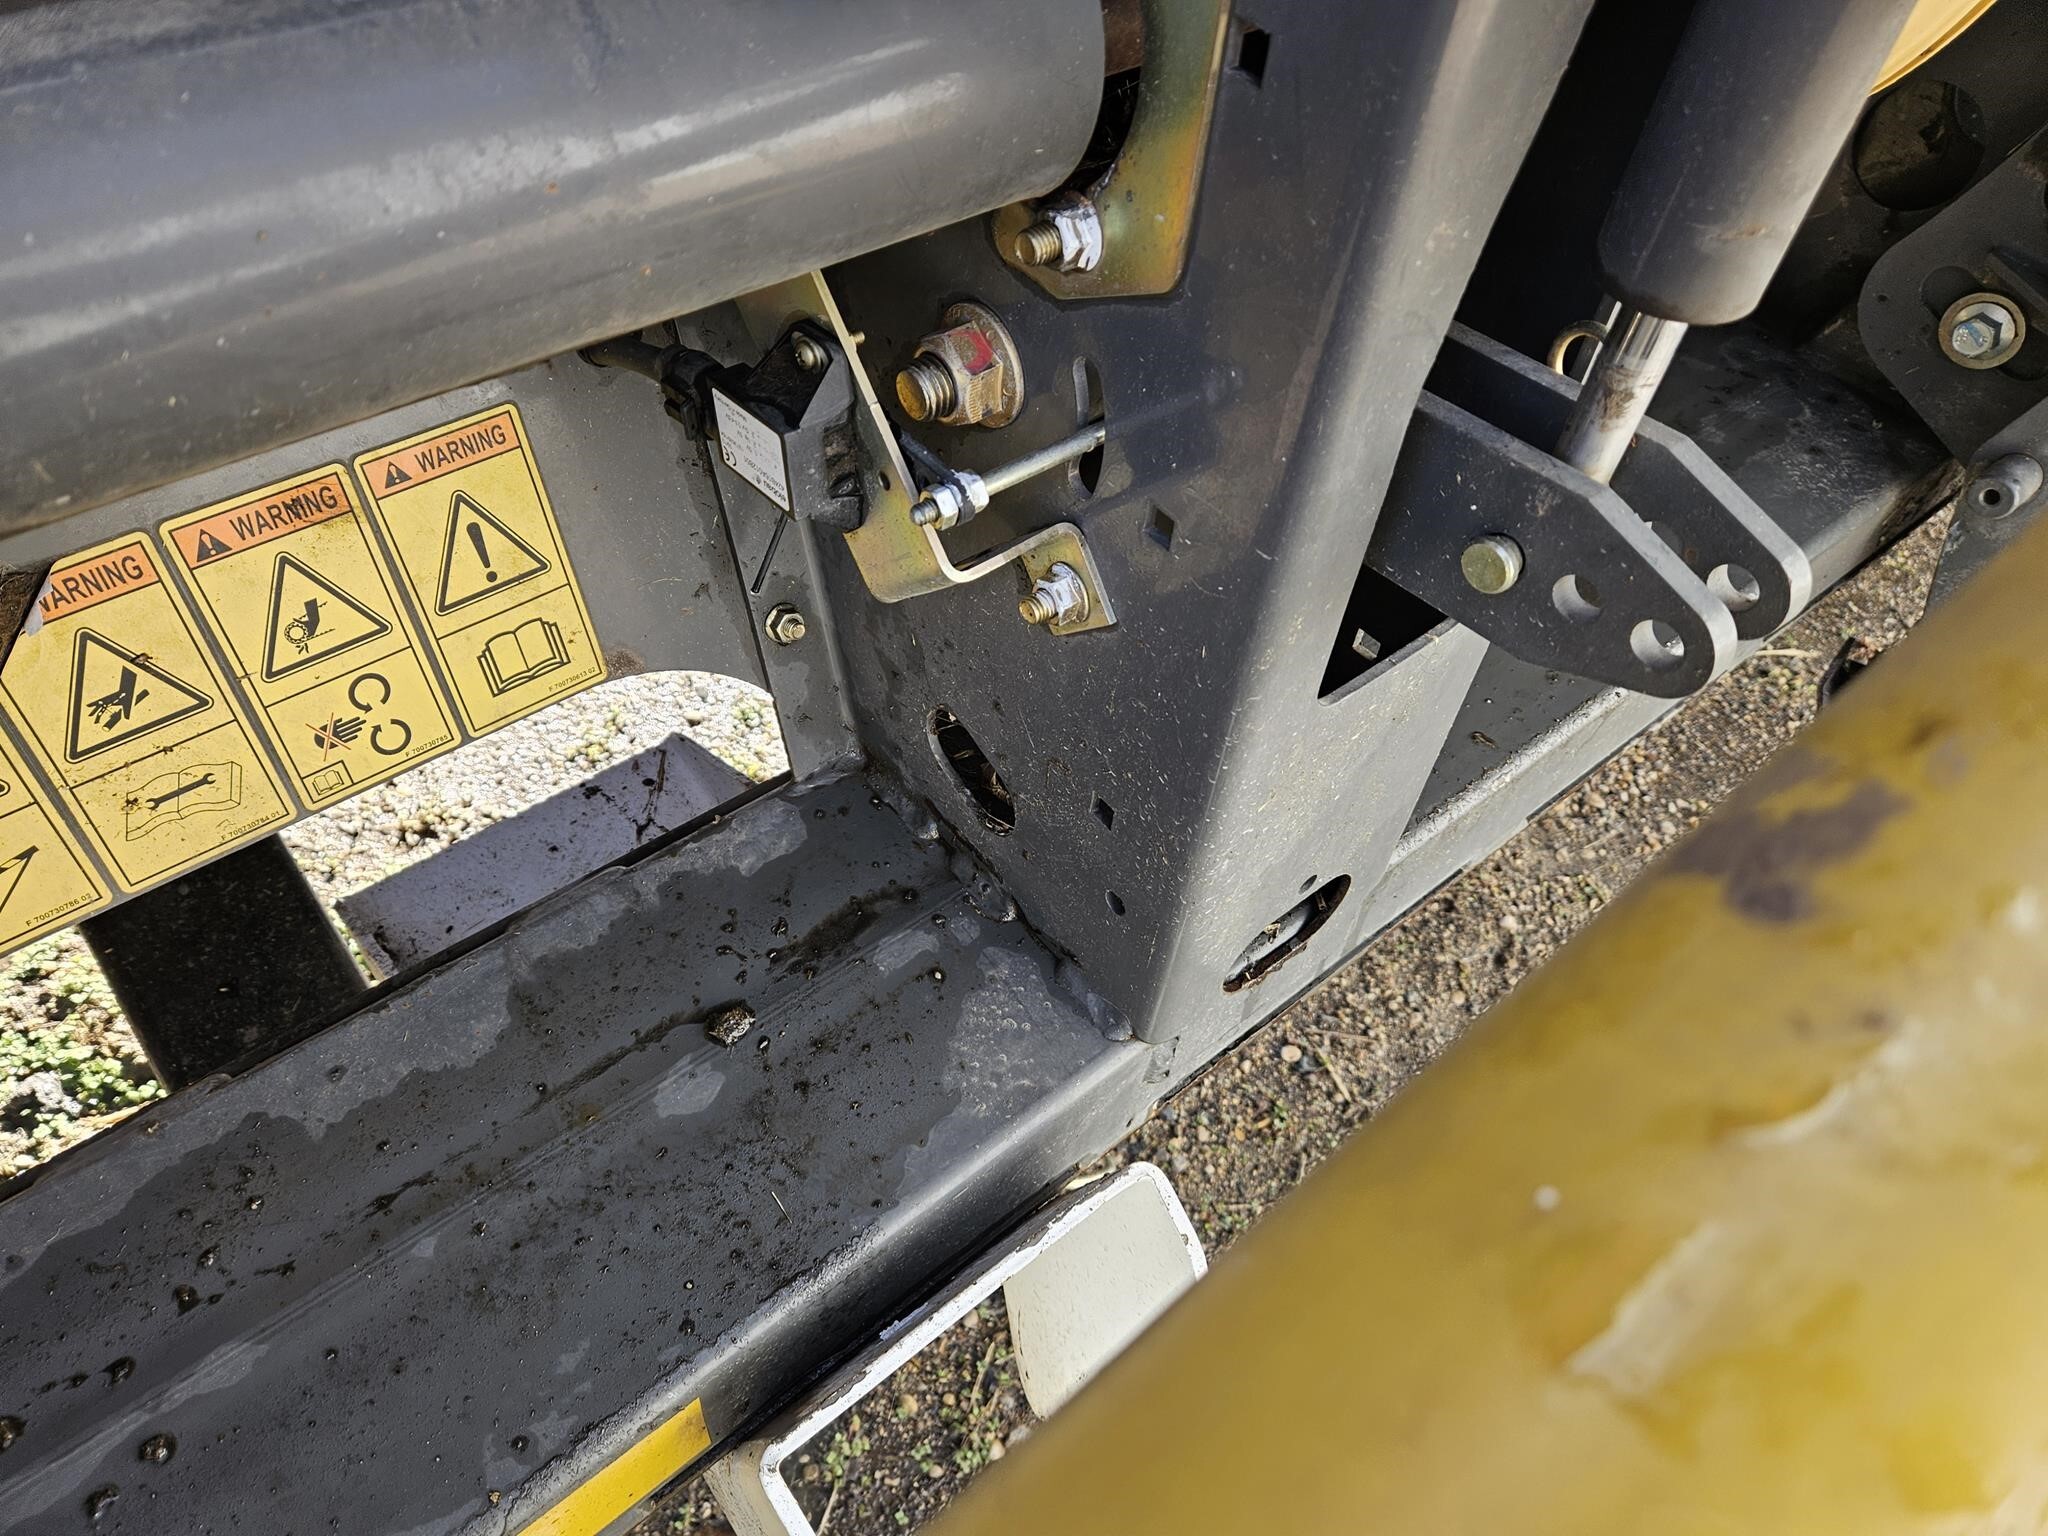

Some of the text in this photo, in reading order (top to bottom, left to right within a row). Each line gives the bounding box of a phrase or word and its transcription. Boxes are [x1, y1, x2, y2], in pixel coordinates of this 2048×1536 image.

[414, 424, 507, 474] WARNING
[229, 485, 338, 541] WARNING
[412, 734, 449, 754] 700730785
[270, 810, 281, 819] 01
[33, 898, 80, 923] 700730786
[80, 892, 92, 902] 02
